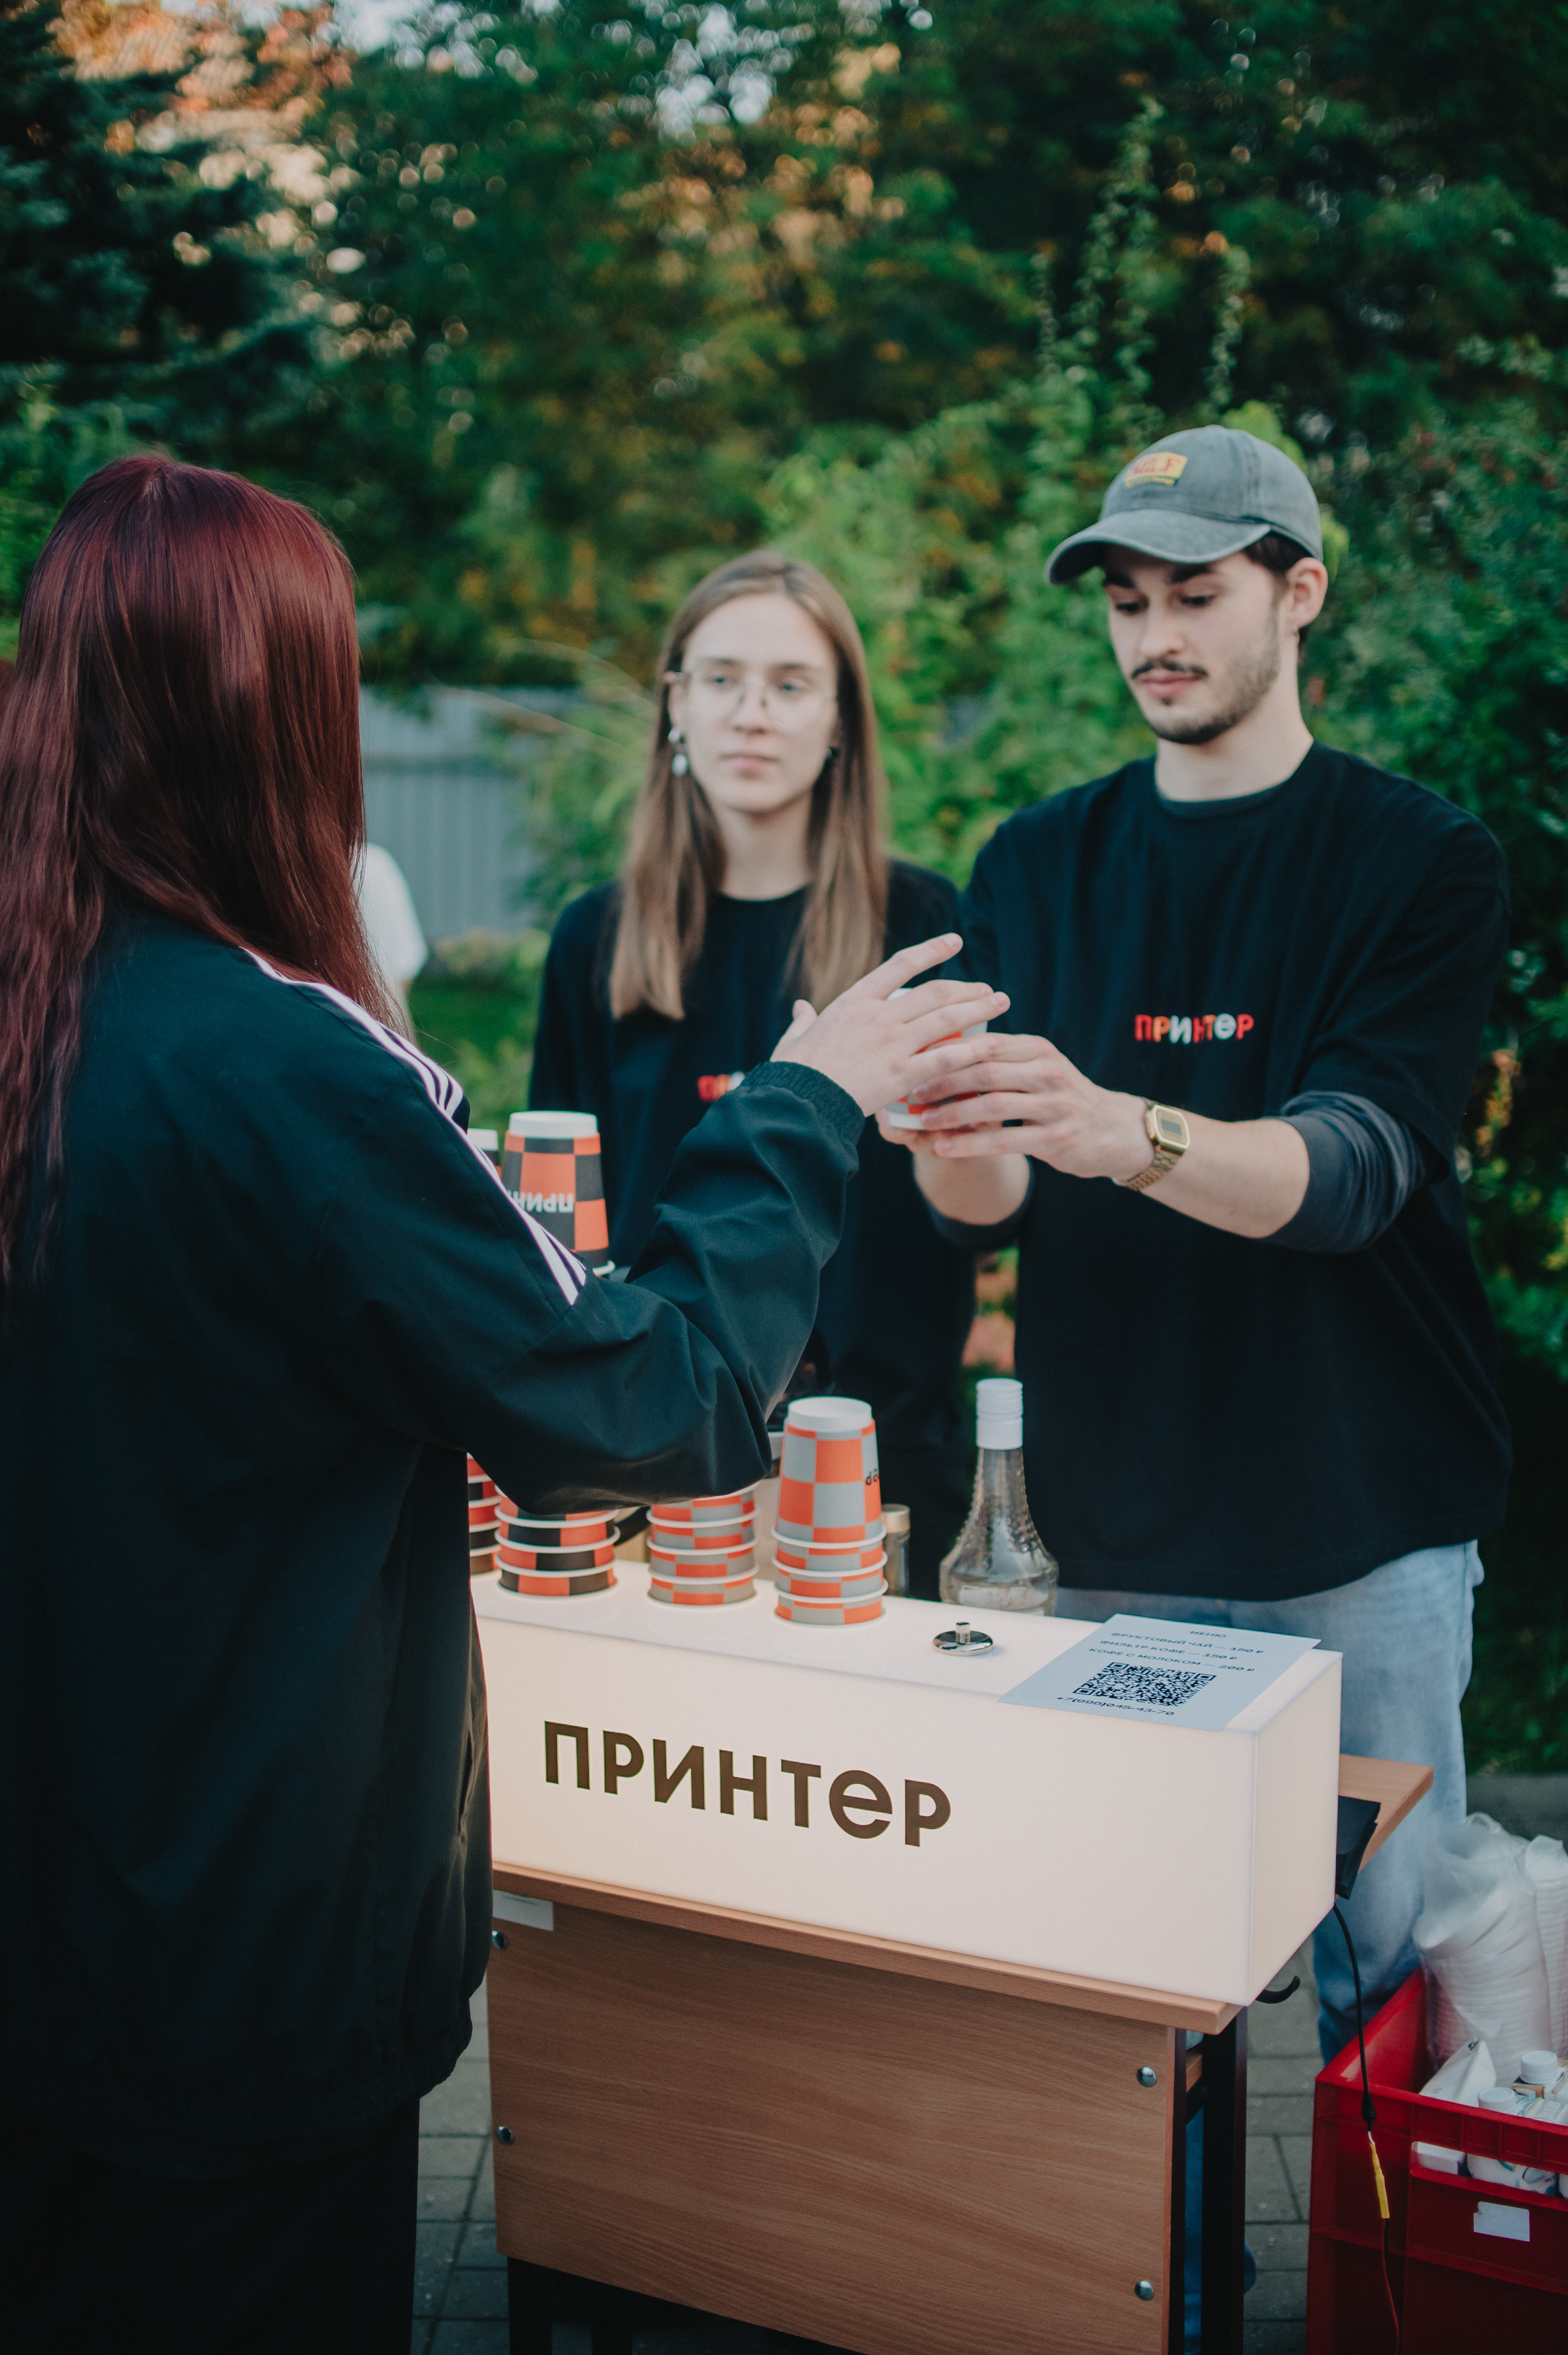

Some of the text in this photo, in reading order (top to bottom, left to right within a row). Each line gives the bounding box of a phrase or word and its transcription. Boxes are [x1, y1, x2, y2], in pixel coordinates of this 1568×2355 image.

[1111, 1632, 1186, 1644] ФРУКТОВЫЙ
[1100, 1640, 1148, 1648] ФИЛЬТР
[1137, 1655, 1201, 1665] МОЛОКОМ
[1056, 1696, 1175, 1716] +7(996)045-43-70
